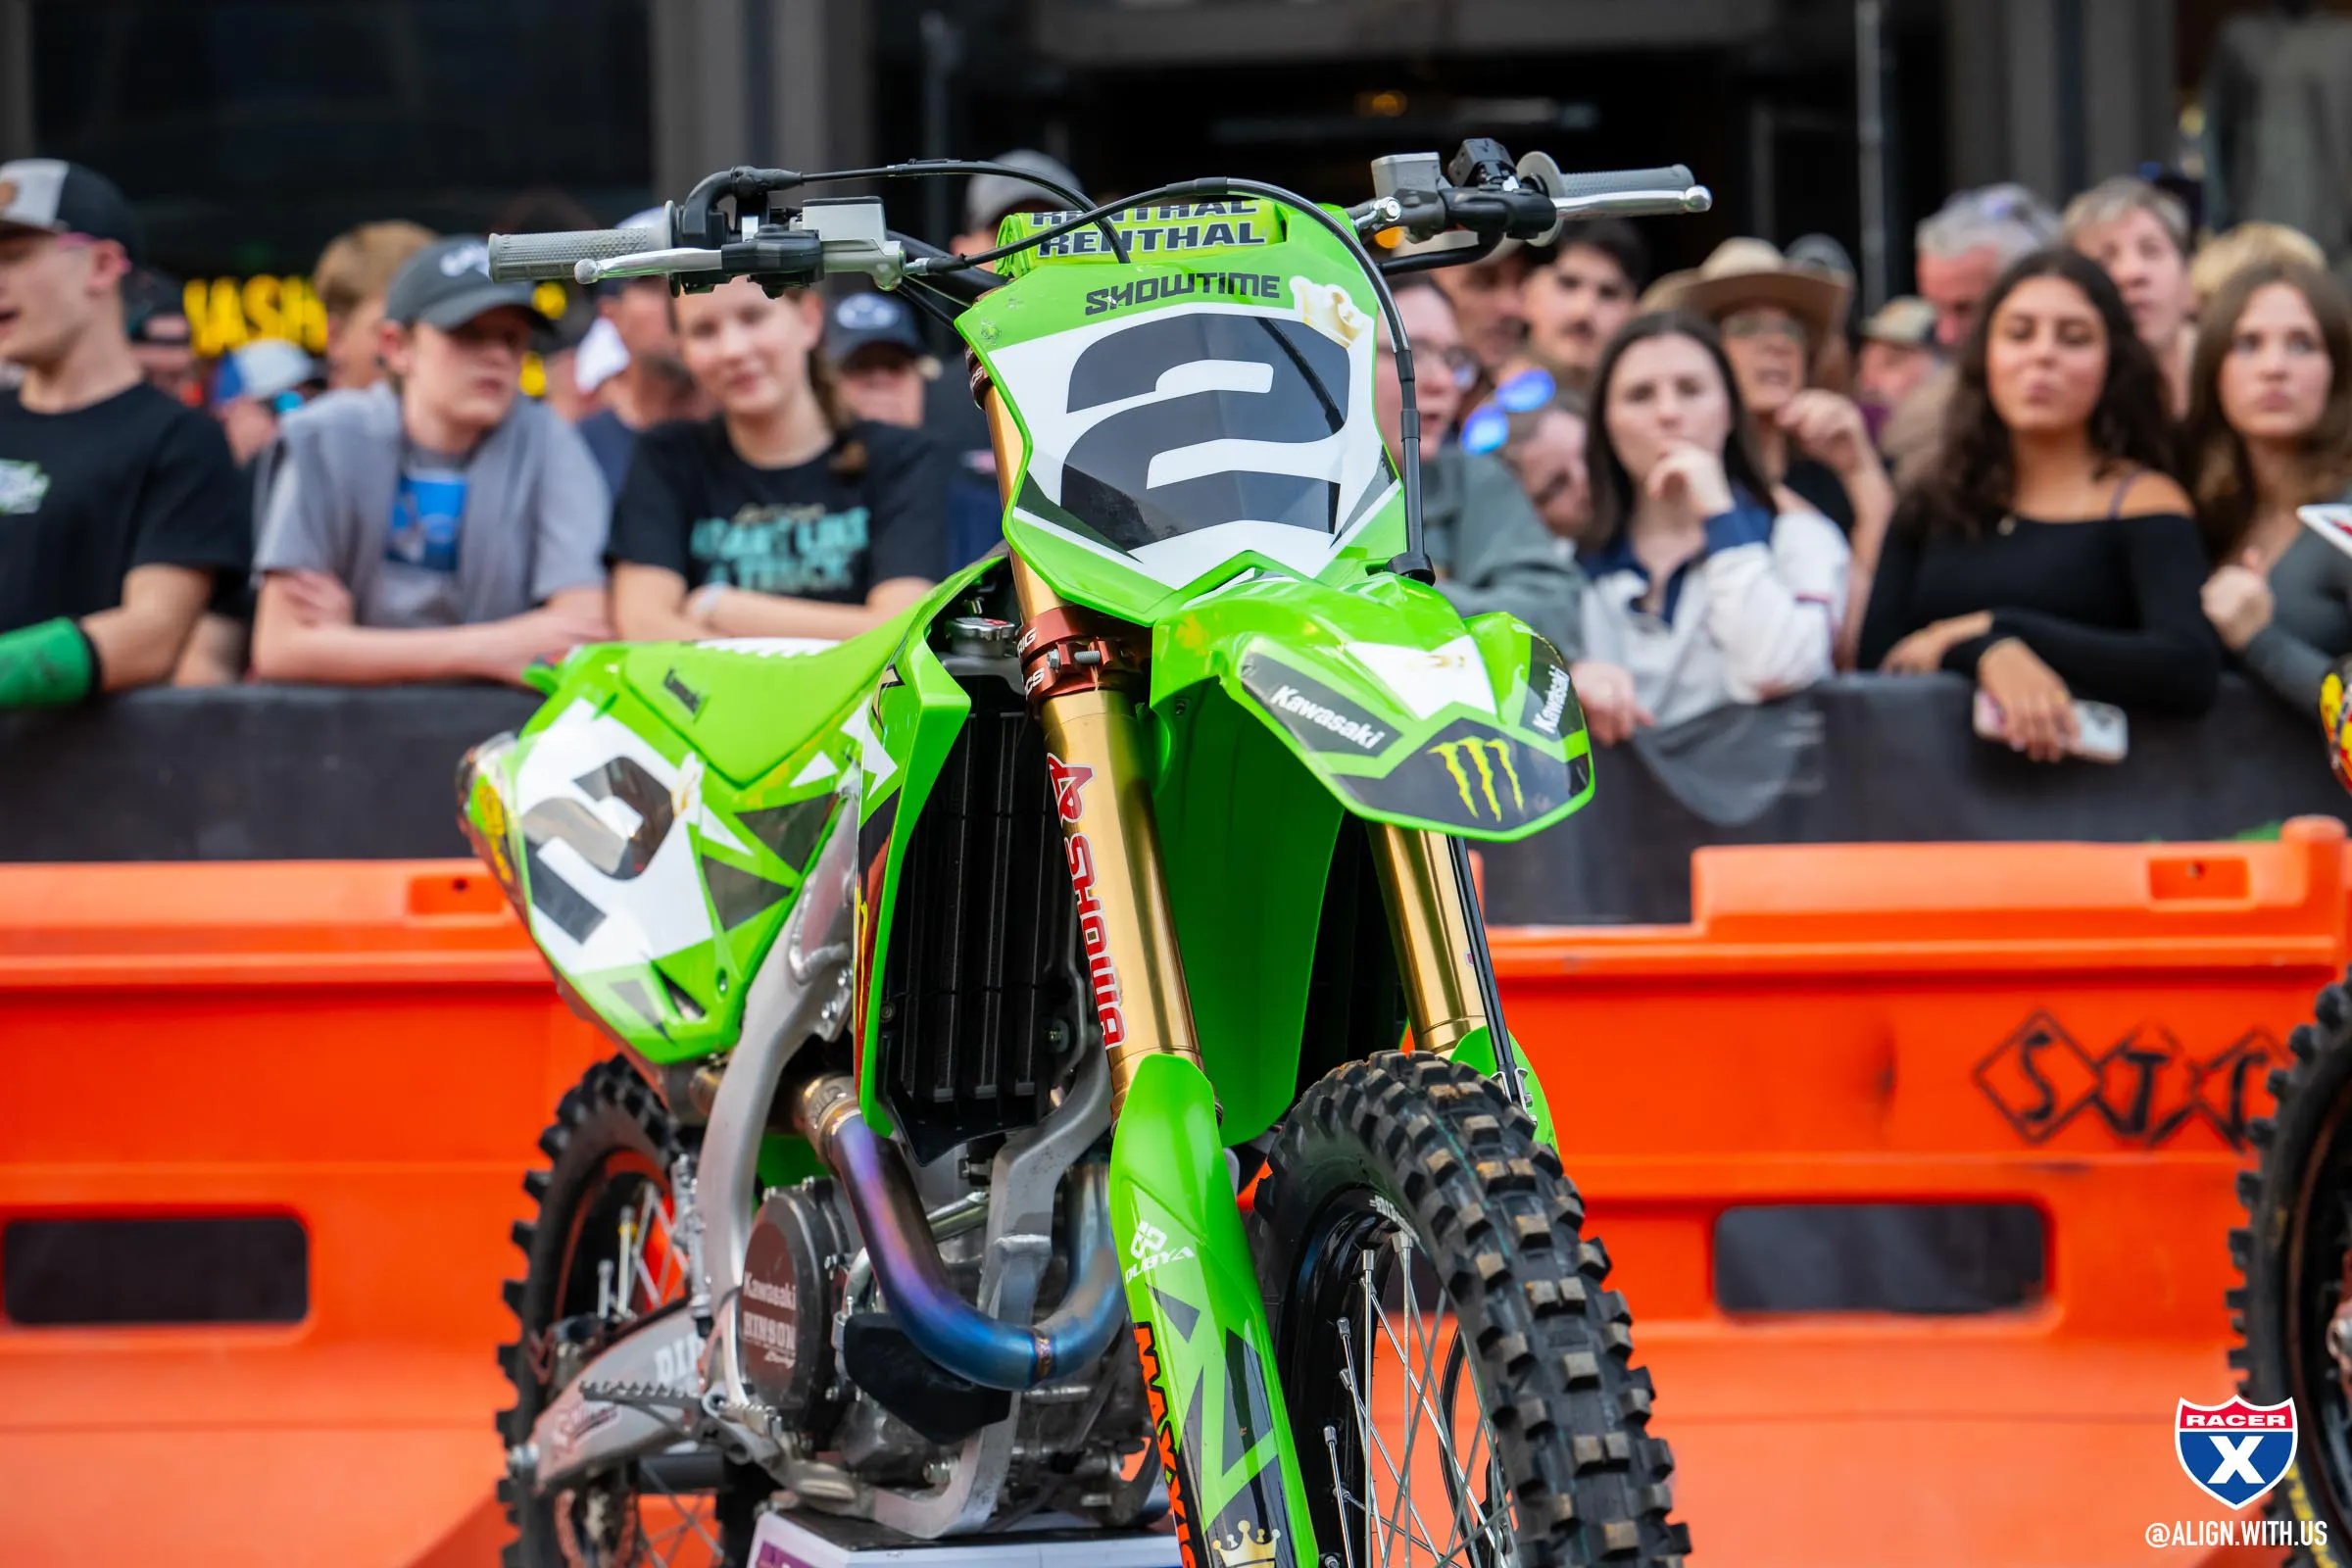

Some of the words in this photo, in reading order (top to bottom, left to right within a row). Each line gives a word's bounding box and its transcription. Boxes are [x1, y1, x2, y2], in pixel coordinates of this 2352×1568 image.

[1038, 220, 1267, 258] RENTHAL
[1085, 271, 1280, 316] SHOWTIME
[1060, 313, 1350, 552] 2
[1270, 685, 1386, 750] Kawasaki
[1532, 663, 1570, 735] Kawasaki
[519, 756, 675, 946] 2
[744, 1271, 797, 1310] Kawasaki
